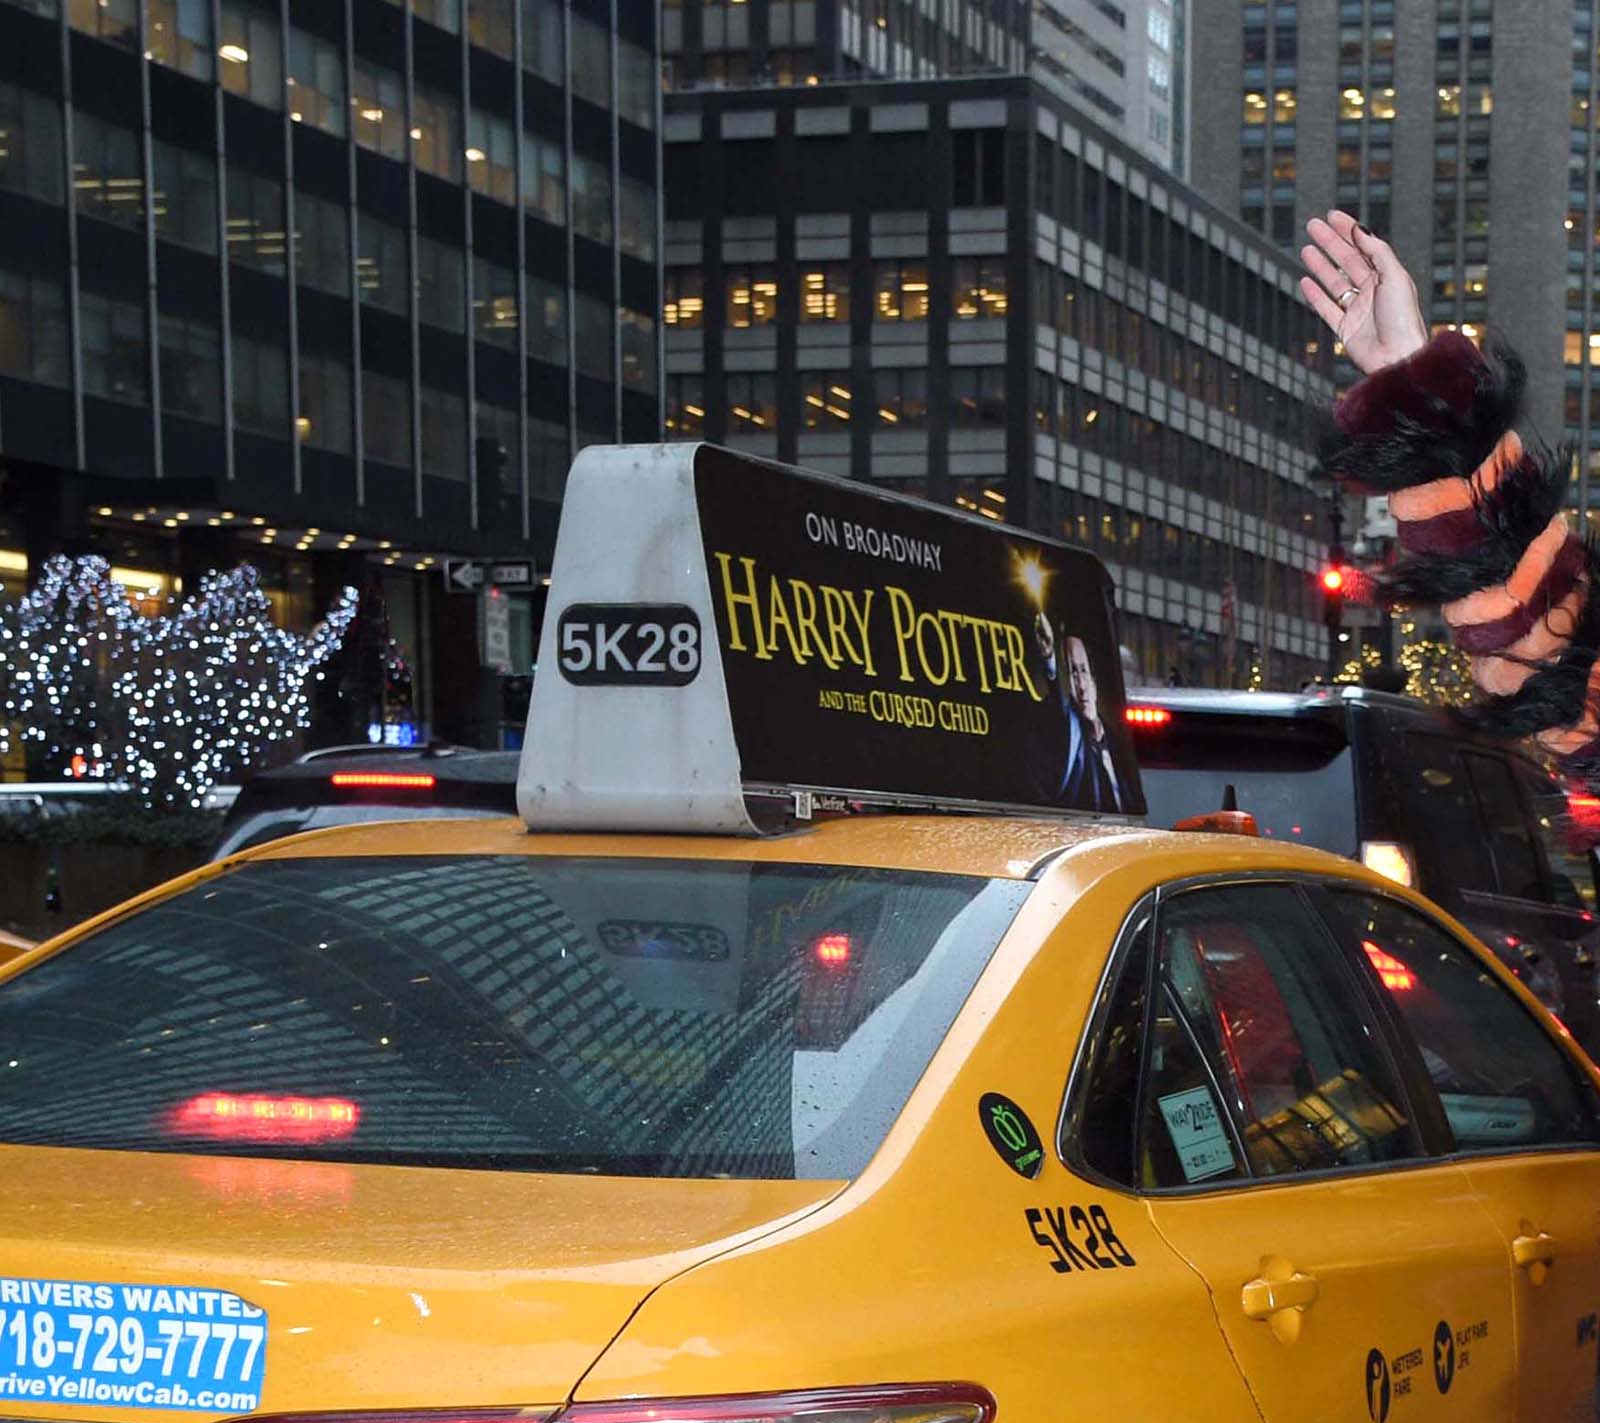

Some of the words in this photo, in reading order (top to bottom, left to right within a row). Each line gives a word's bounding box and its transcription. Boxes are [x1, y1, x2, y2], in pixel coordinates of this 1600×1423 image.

[805, 512, 839, 547] ON
[843, 521, 942, 572] BROADWAY
[562, 622, 700, 673] 5K28
[714, 552, 879, 677] HARRY
[884, 585, 1043, 702] POTTER
[819, 690, 845, 711] AND
[846, 693, 867, 714] THE
[868, 689, 936, 729] CURSED
[938, 701, 990, 736] CHILD
[1024, 1204, 1137, 1274] 5K28
